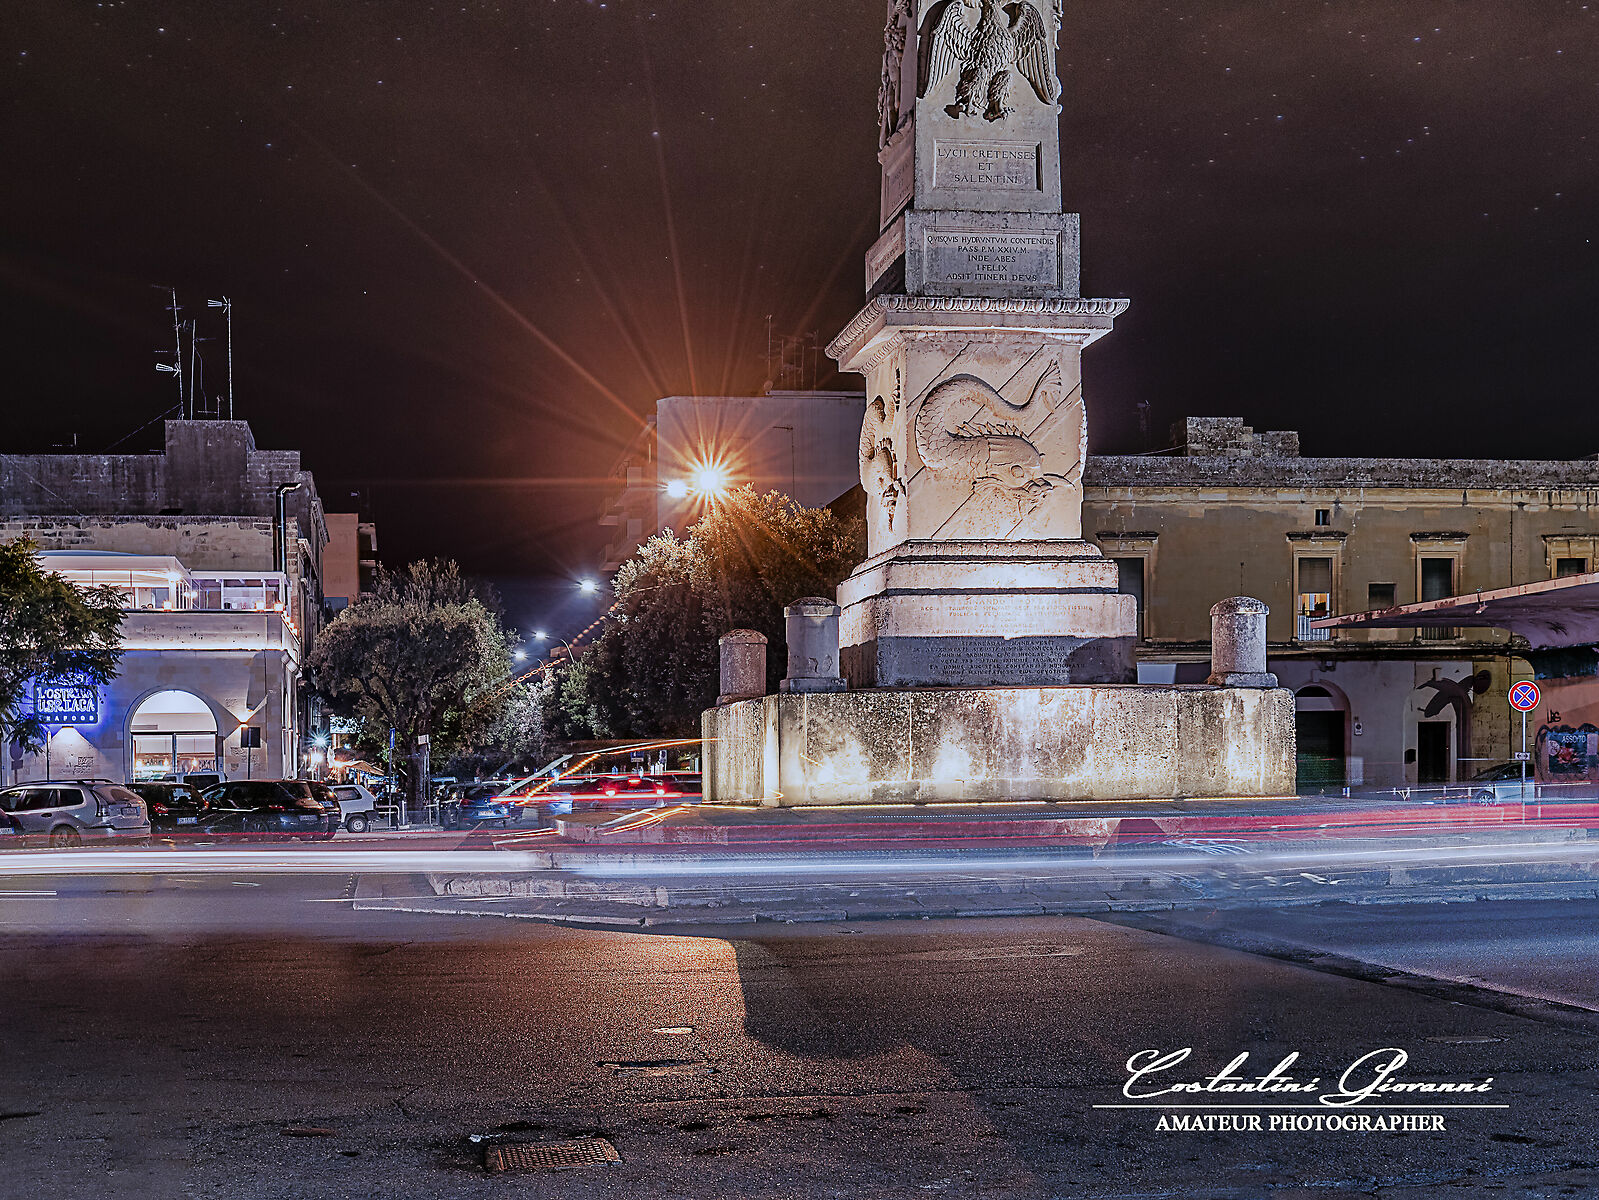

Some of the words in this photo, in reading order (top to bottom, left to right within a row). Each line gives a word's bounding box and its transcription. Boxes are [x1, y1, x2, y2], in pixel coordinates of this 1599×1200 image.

[973, 150, 1036, 160] CRETENSES
[978, 162, 993, 170] ET
[954, 174, 1018, 184] SALENTINI
[994, 255, 1016, 263] ABES
